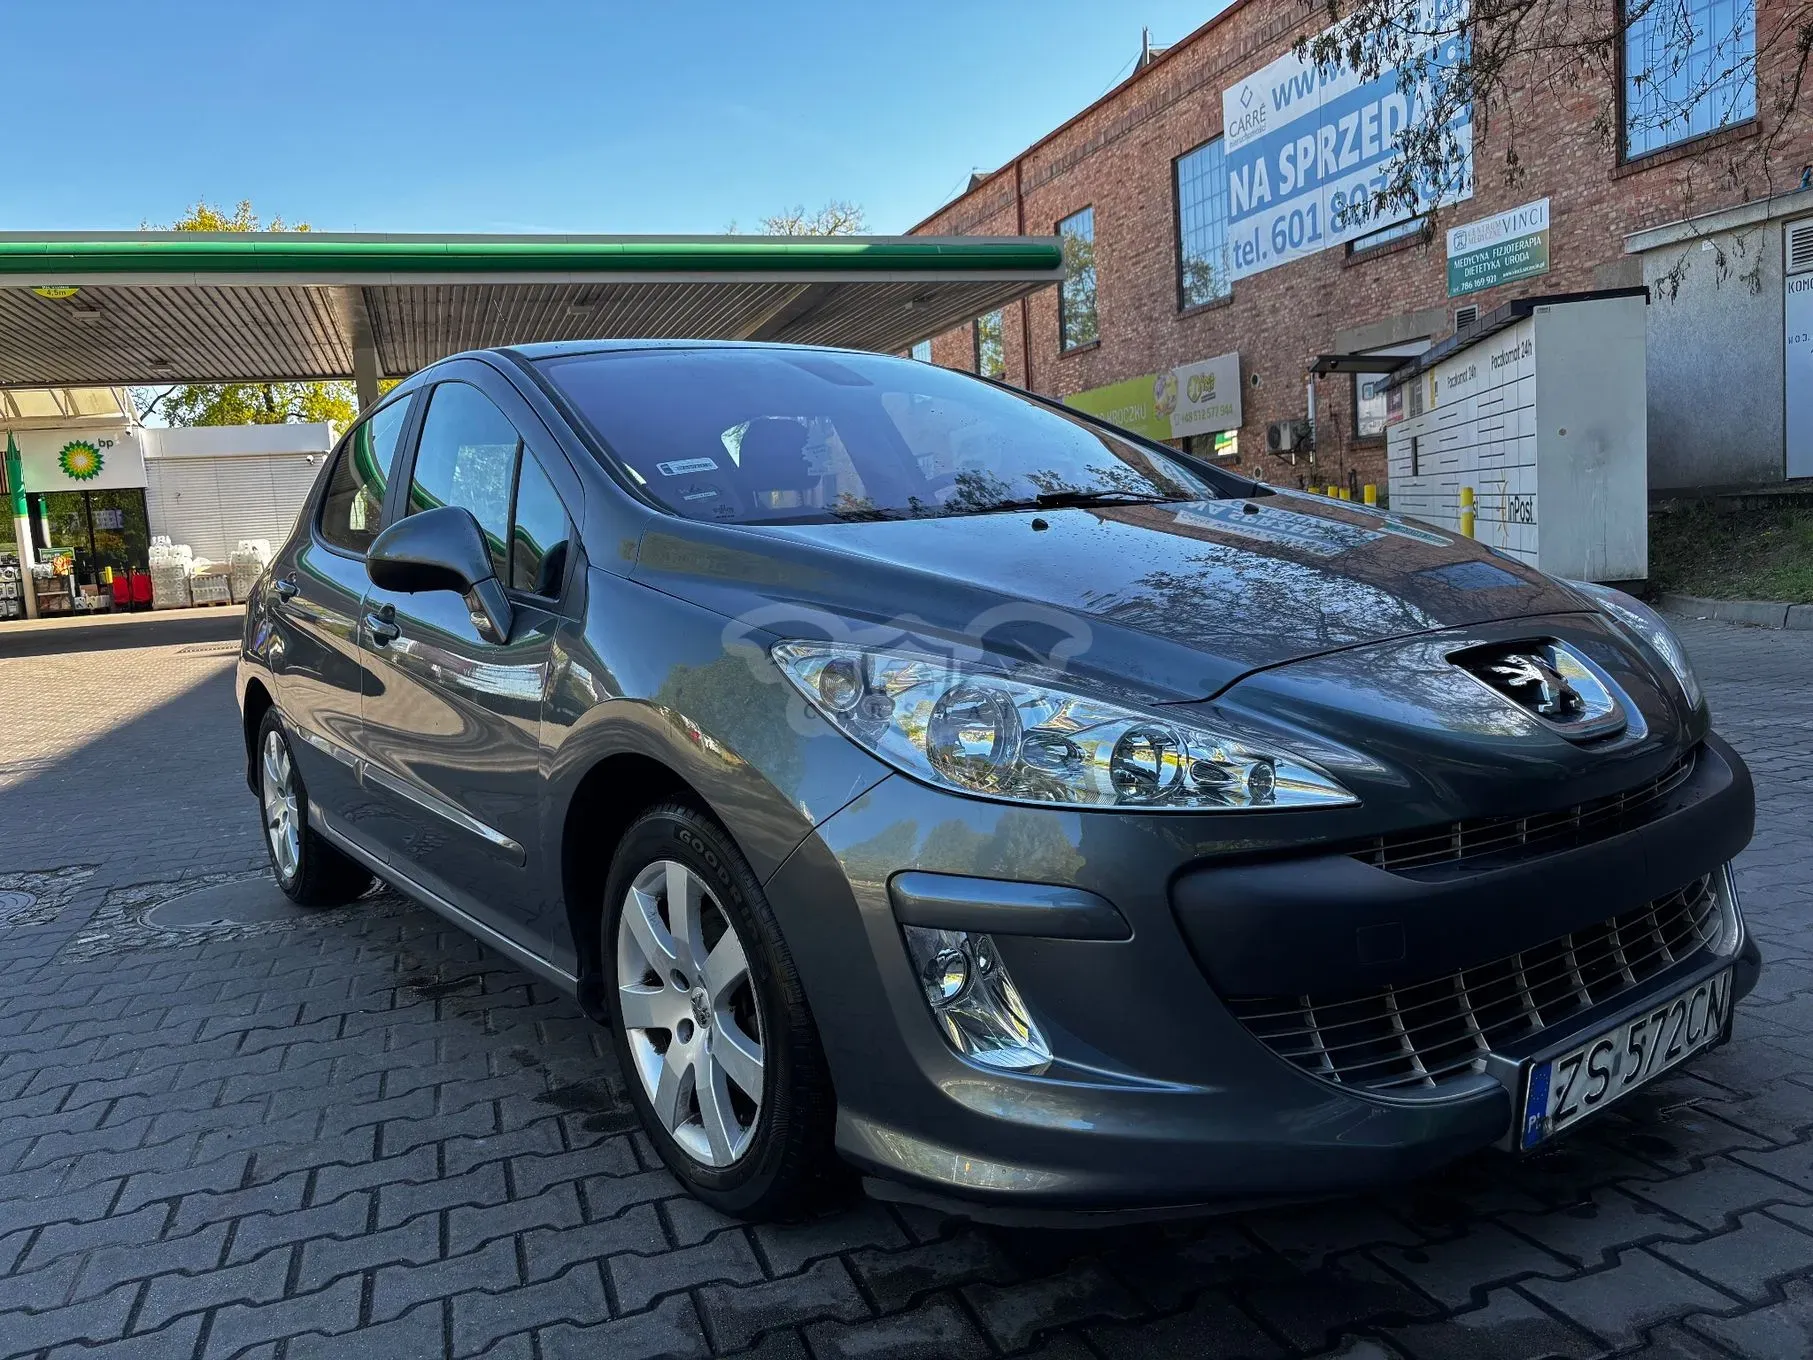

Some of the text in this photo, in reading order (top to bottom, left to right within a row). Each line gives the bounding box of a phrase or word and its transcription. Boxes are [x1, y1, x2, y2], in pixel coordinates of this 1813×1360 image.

[1229, 103, 1266, 138] CARRÉ
[1230, 157, 1272, 217] NA
[1278, 45, 1469, 196] SPRZEDA
[1233, 227, 1267, 269] tel.
[1271, 203, 1322, 254] 601
[1502, 206, 1543, 233] VINCI
[1454, 236, 1541, 269] MEDYCYNA FIZJOTERAPIA
[1464, 251, 1530, 277] DIETETYKA URODA
[1461, 281, 1473, 291] 786
[1474, 277, 1485, 287] 169
[1486, 274, 1497, 284] 921
[1491, 338, 1533, 371] Paczkomat 24h
[97, 438, 114, 449] bp
[1507, 495, 1533, 522] InPost
[1554, 972, 1726, 1121] ZS 572CN
